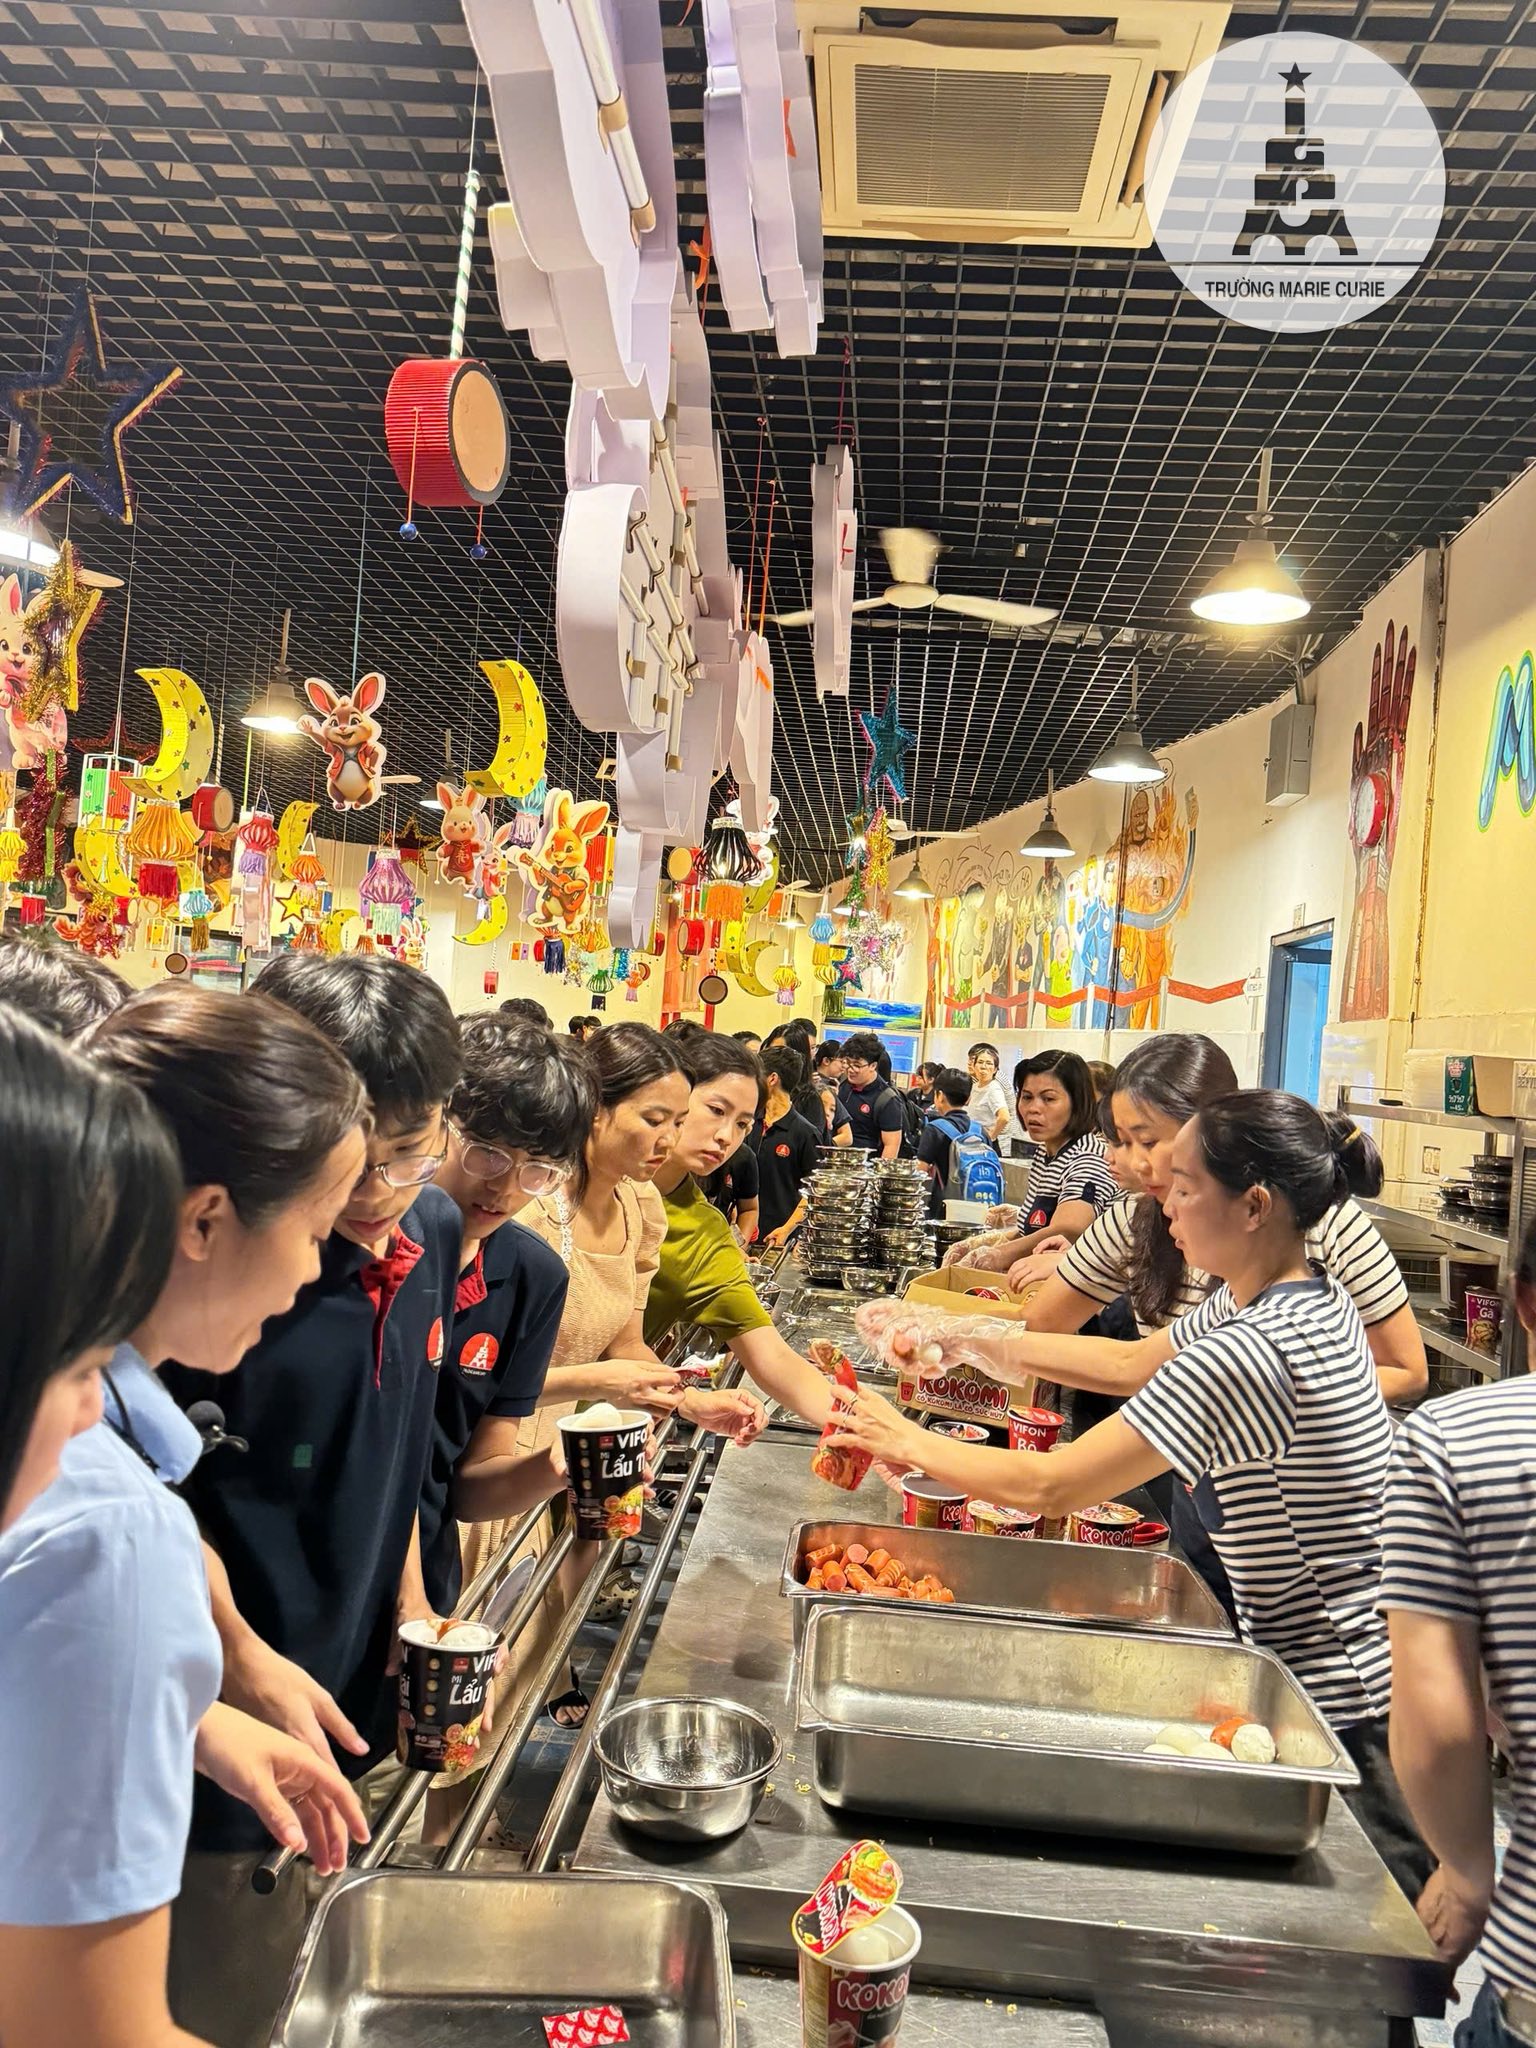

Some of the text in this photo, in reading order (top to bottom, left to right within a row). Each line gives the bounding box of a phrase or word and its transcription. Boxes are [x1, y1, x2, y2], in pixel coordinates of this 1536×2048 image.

[1477, 1297, 1496, 1307] VIFO
[917, 1374, 1010, 1412] KOKOMI
[617, 1430, 647, 1449] VIFO
[1013, 1420, 1047, 1438] VIFON
[602, 1453, 633, 1479] Lẩu
[942, 1504, 963, 1522] KO
[1080, 1524, 1135, 1547] KOKOM
[473, 1652, 496, 1673] VIF
[449, 1678, 483, 1705] Lẩu
[837, 1966, 912, 2012] KOKO
